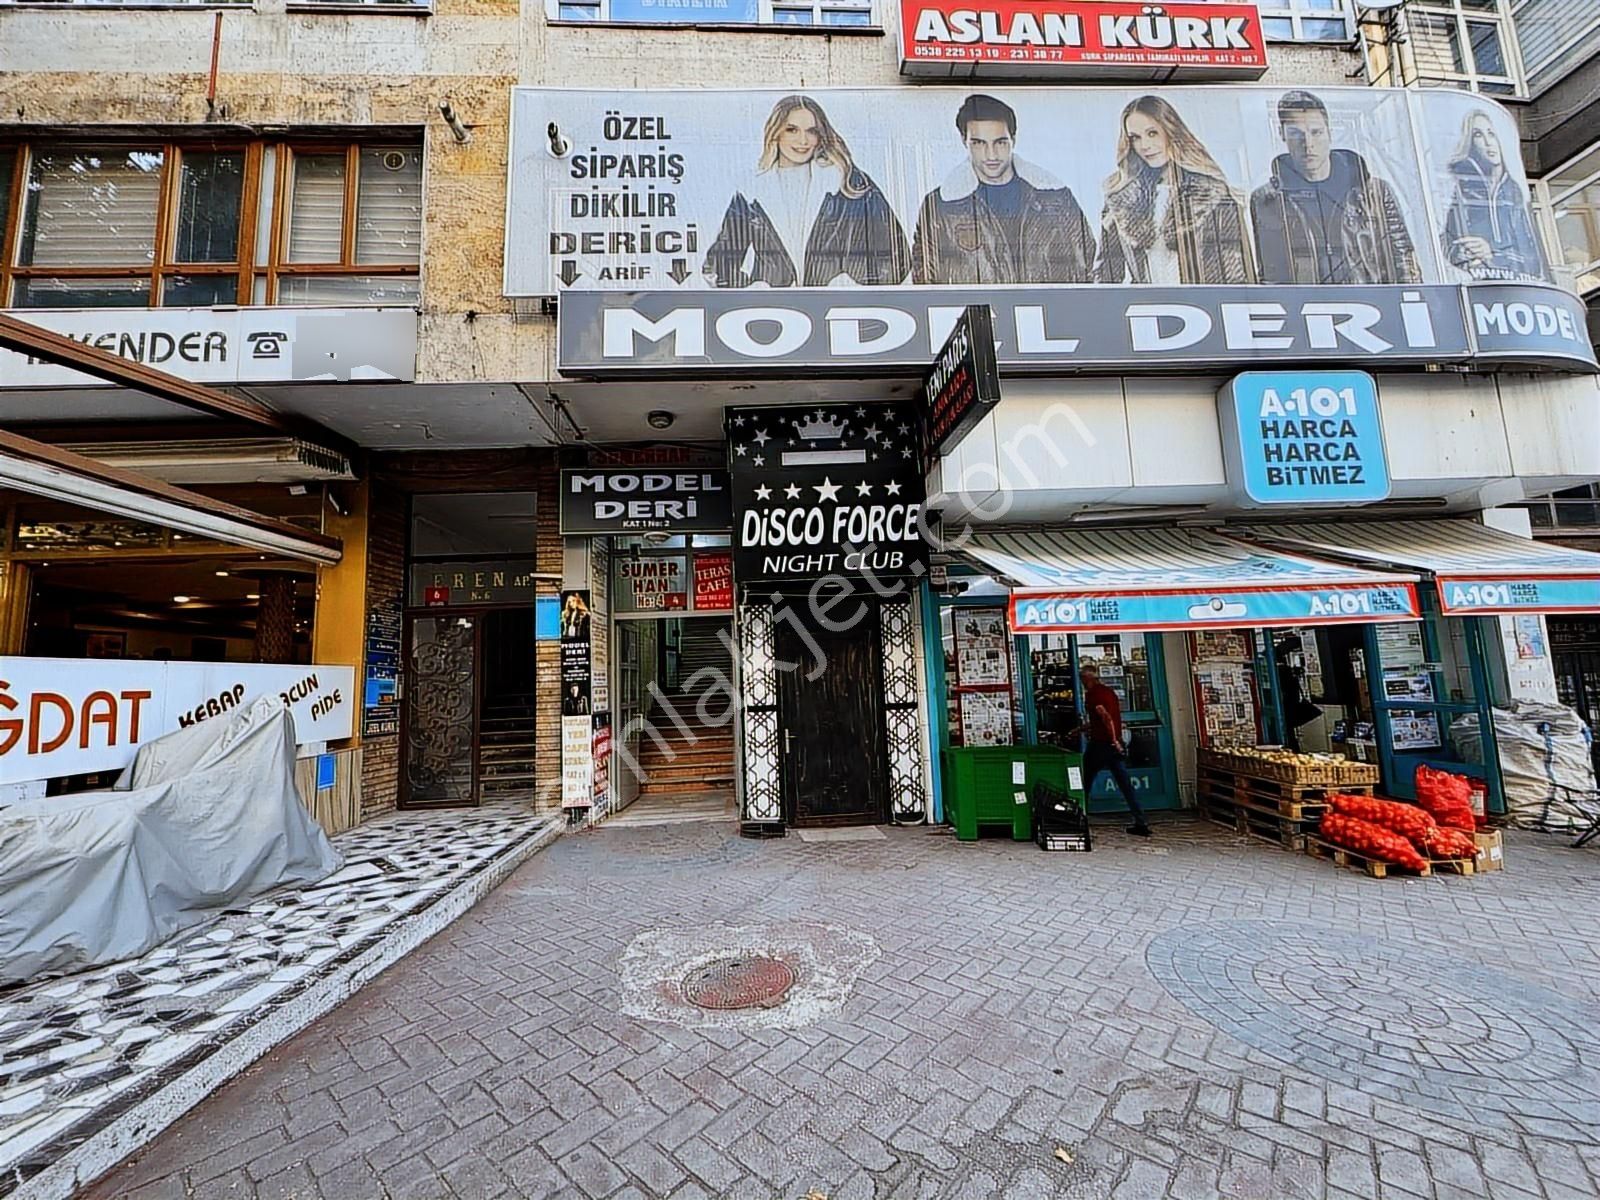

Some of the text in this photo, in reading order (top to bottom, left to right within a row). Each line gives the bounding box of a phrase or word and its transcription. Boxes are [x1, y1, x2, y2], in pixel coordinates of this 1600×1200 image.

[914, 5, 1252, 49] ASLAN KÜRK
[603, 110, 672, 141] ÖZEL
[570, 145, 685, 184] SİPARİŞ
[570, 185, 677, 218] DİKİLİR
[549, 224, 698, 255] DERİCİ
[598, 262, 651, 281] ARİF
[1124, 290, 1437, 354] DERİ
[1472, 302, 1585, 345] MODEL
[1260, 419, 1358, 439] HARCA
[1263, 442, 1361, 463] HARCA
[571, 474, 723, 493] MODEL
[594, 496, 697, 520] DERİ
[832, 503, 921, 544] FORCE
[621, 561, 679, 577] SUMER
[695, 564, 732, 581] TERAS
[763, 550, 904, 574] NIGHT CLUB
[433, 571, 504, 589] EREN
[632, 578, 669, 594] HAN
[697, 577, 730, 594] CAFE
[311, 688, 342, 721] PİDE
